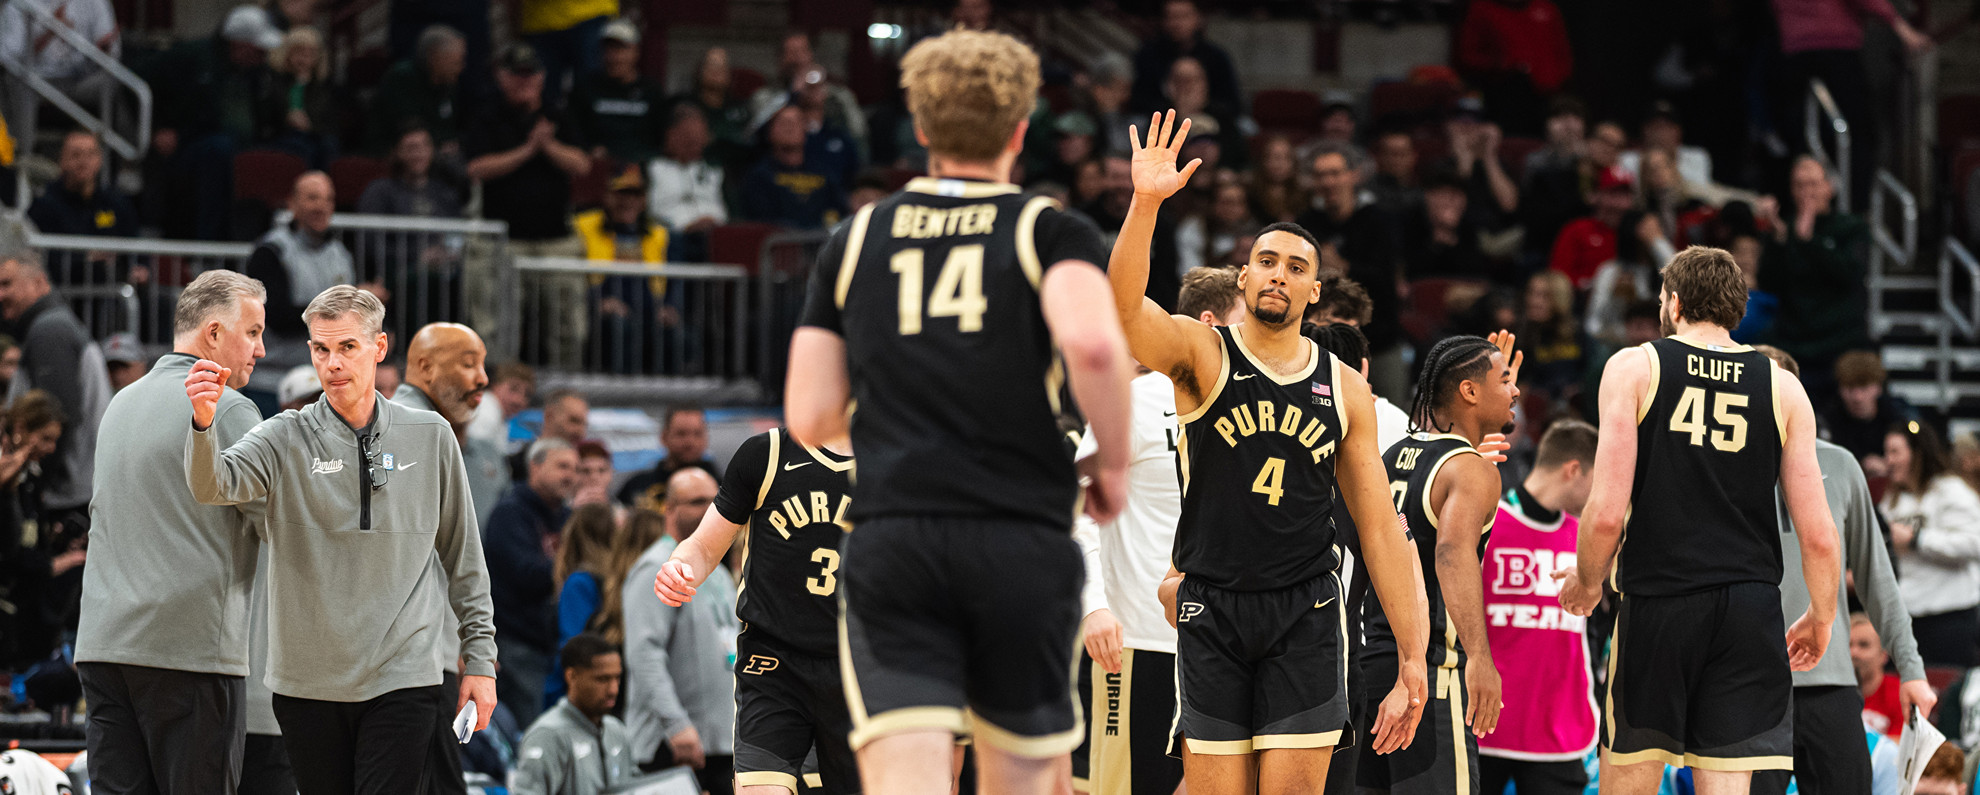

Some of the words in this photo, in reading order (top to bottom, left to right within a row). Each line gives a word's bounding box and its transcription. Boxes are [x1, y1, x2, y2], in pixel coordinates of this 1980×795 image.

[891, 203, 998, 239] BENTER
[890, 243, 988, 336] 14
[1687, 353, 1745, 384] CLUFF
[1213, 400, 1336, 465] PURDUE
[1669, 386, 1749, 453] 45
[311, 457, 344, 475] Purdue
[1251, 456, 1286, 507] 4
[1395, 446, 1424, 470] COX
[806, 547, 841, 597] 3
